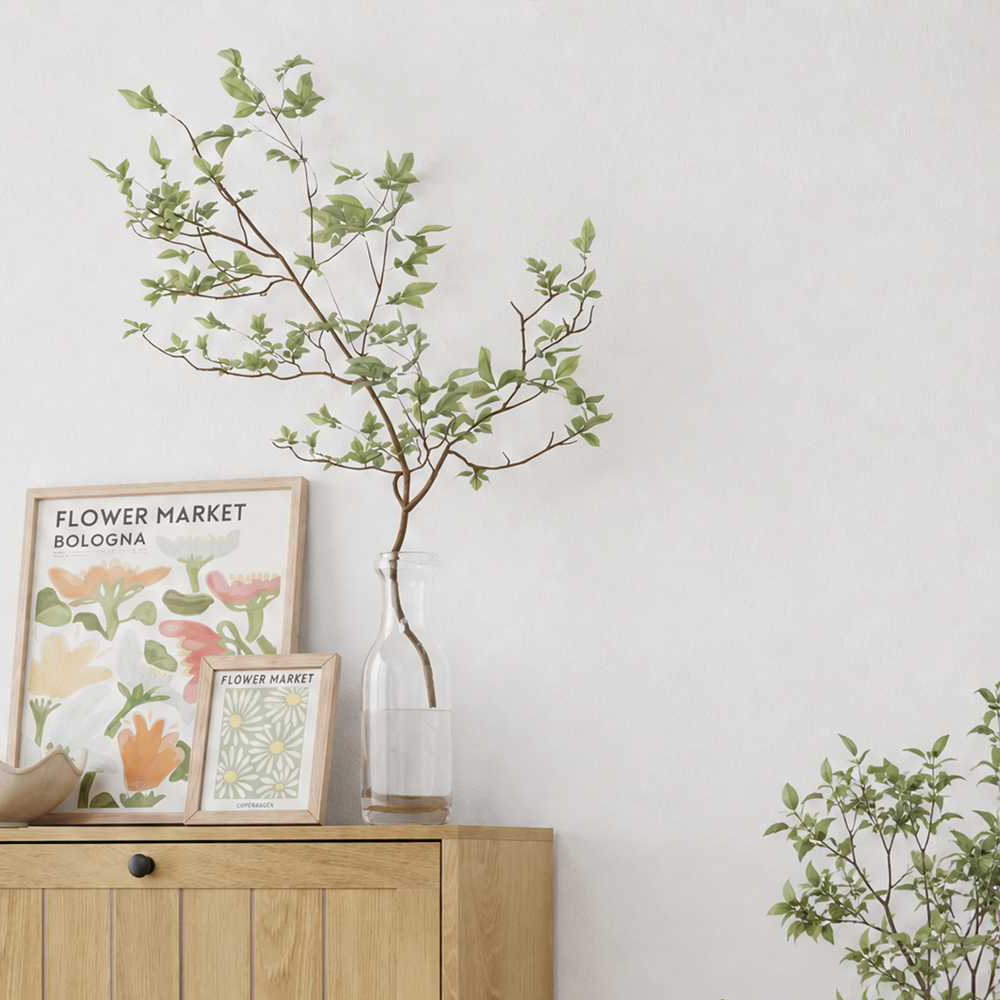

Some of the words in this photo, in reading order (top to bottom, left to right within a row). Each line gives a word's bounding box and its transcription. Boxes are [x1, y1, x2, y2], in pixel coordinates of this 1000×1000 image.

[55, 507, 149, 528] FLOWER
[156, 503, 247, 524] MARKET
[53, 532, 146, 549] BOLOGNA
[220, 674, 266, 685] FLOWER
[269, 673, 315, 684] MARKET
